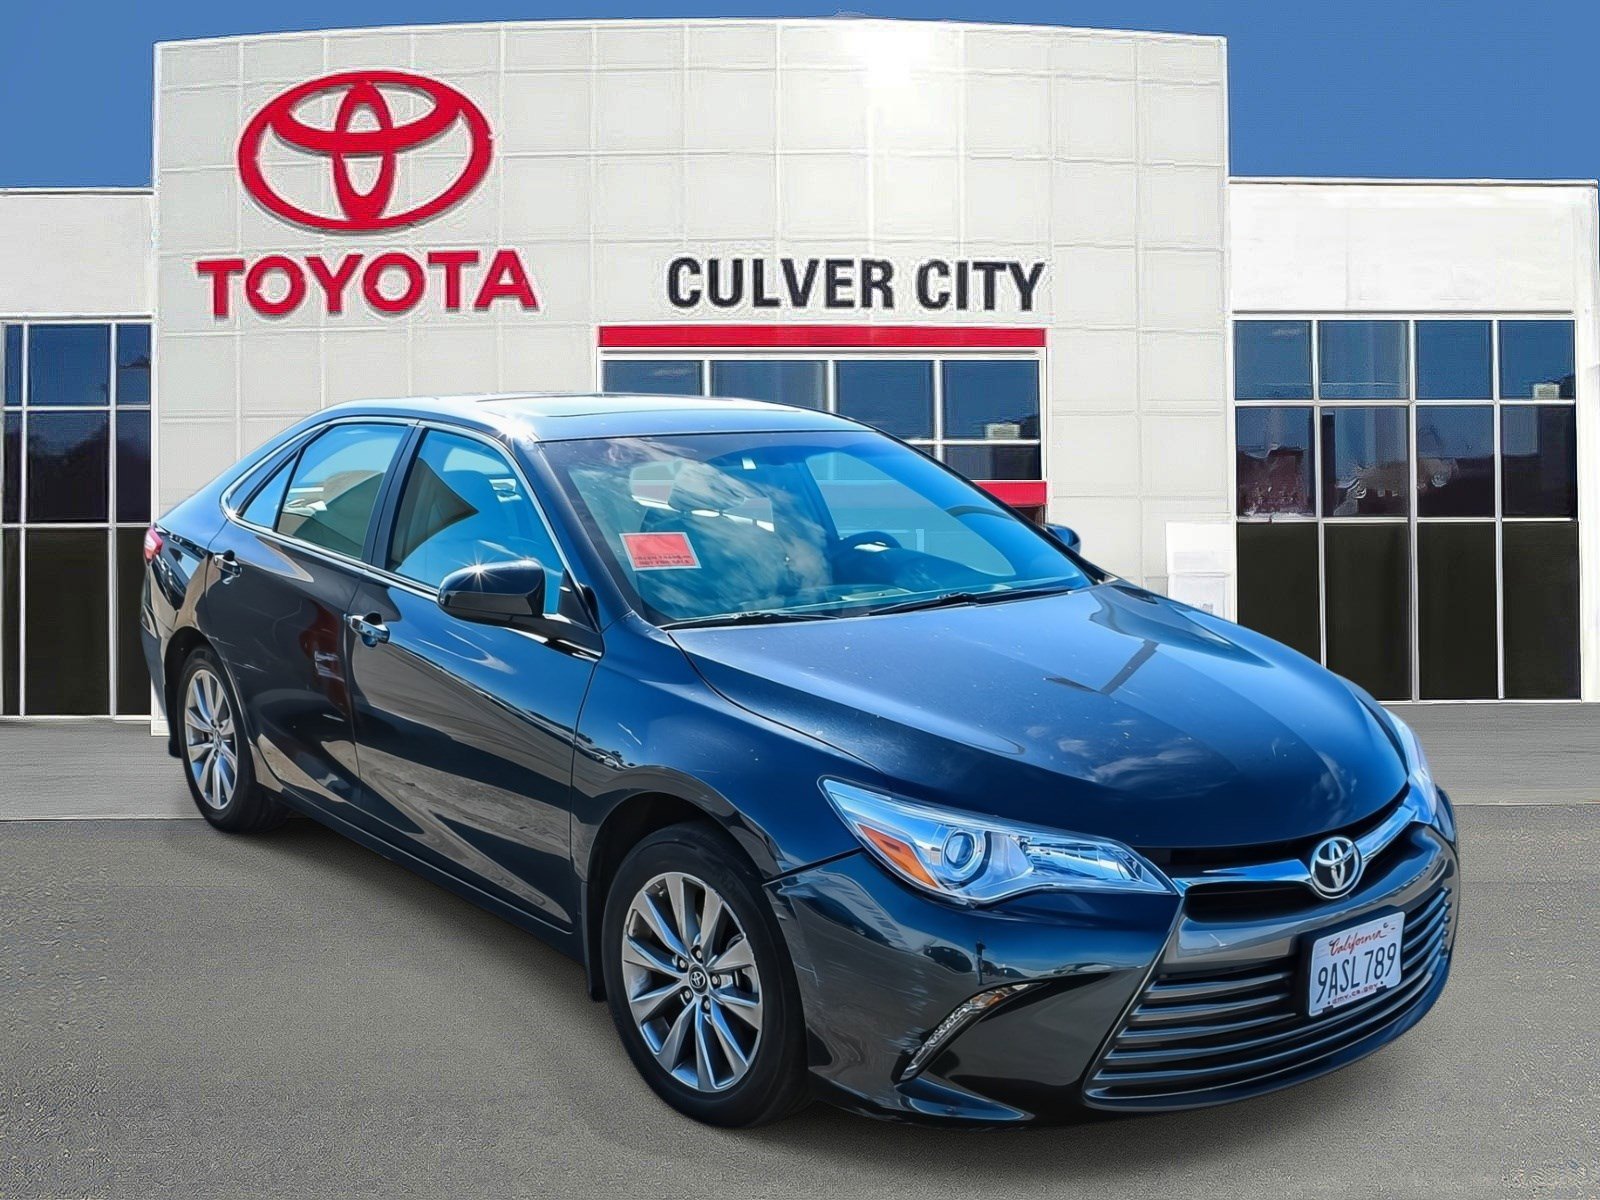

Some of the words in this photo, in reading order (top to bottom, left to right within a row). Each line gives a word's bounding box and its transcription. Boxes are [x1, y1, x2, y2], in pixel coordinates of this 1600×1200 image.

[196, 250, 539, 318] TOYOTA
[667, 257, 895, 309] CULVER
[916, 259, 1046, 312] CITY
[1329, 930, 1387, 956] California
